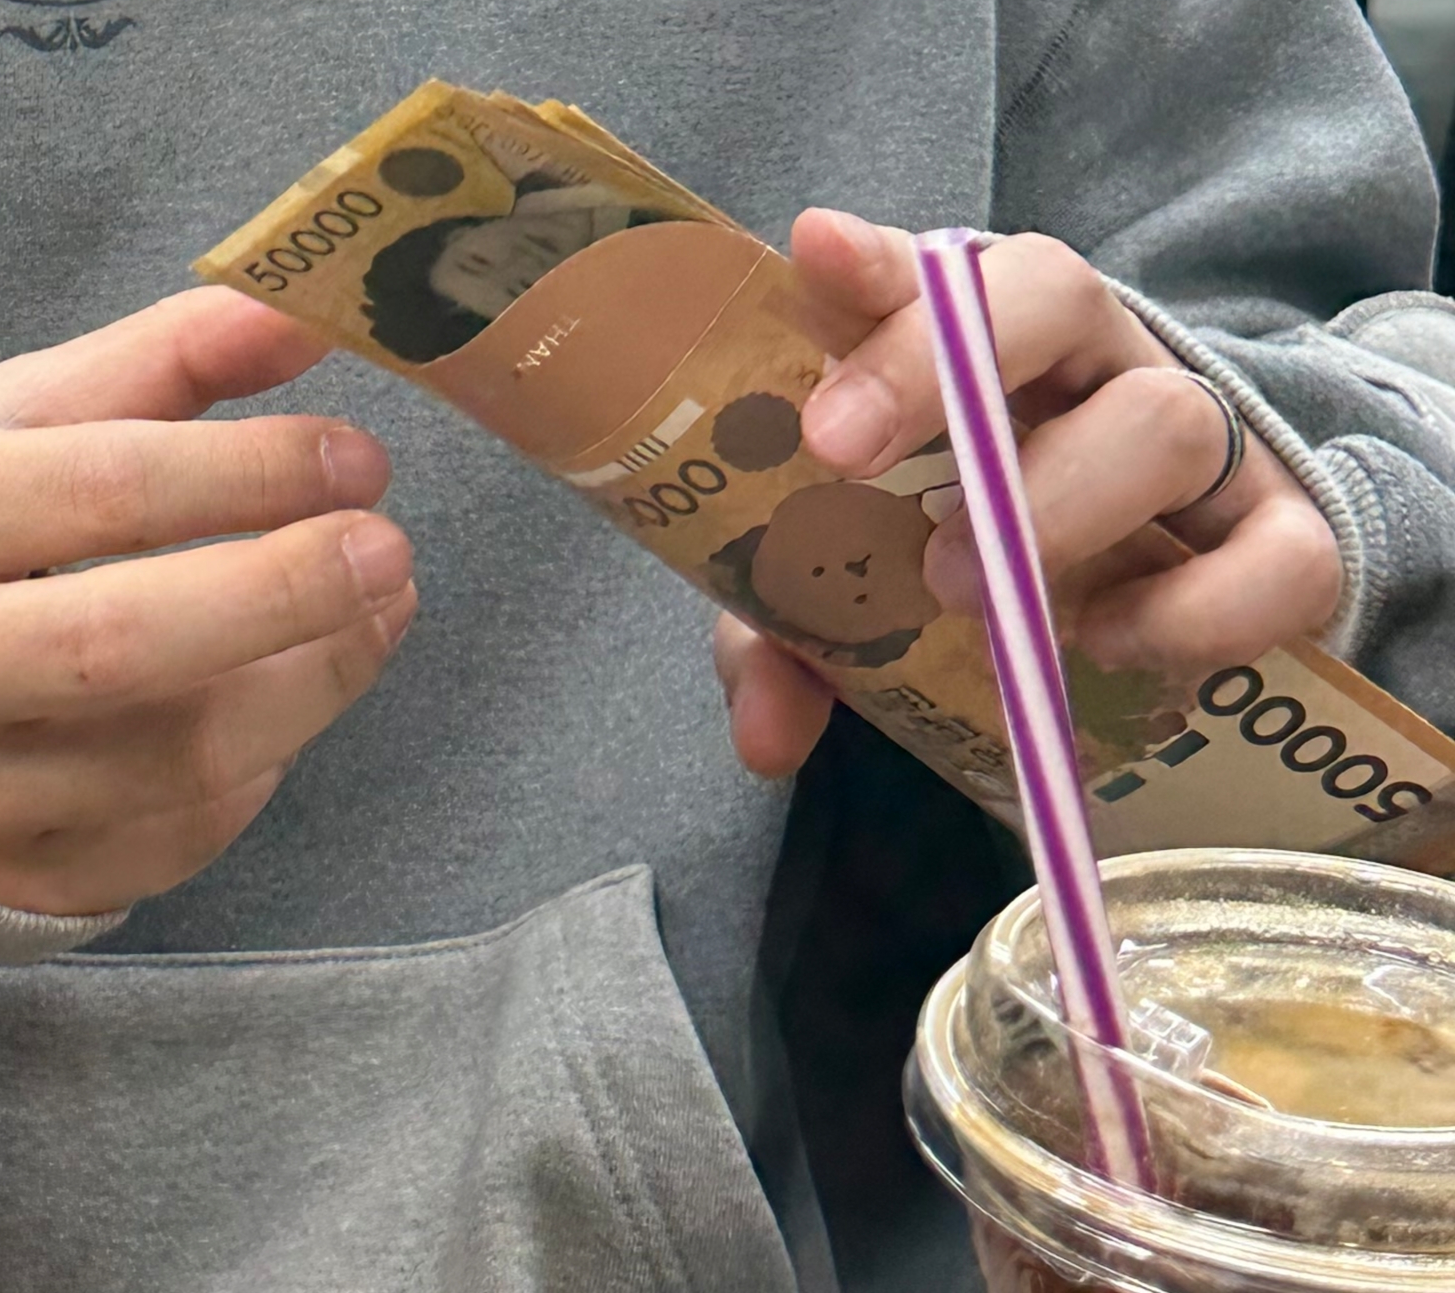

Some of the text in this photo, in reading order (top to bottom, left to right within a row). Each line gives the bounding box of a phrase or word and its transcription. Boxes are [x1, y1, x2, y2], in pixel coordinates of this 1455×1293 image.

[244, 189, 384, 292] 50000
[513, 316, 582, 380] THAN
[1196, 664, 1433, 823] 50000
